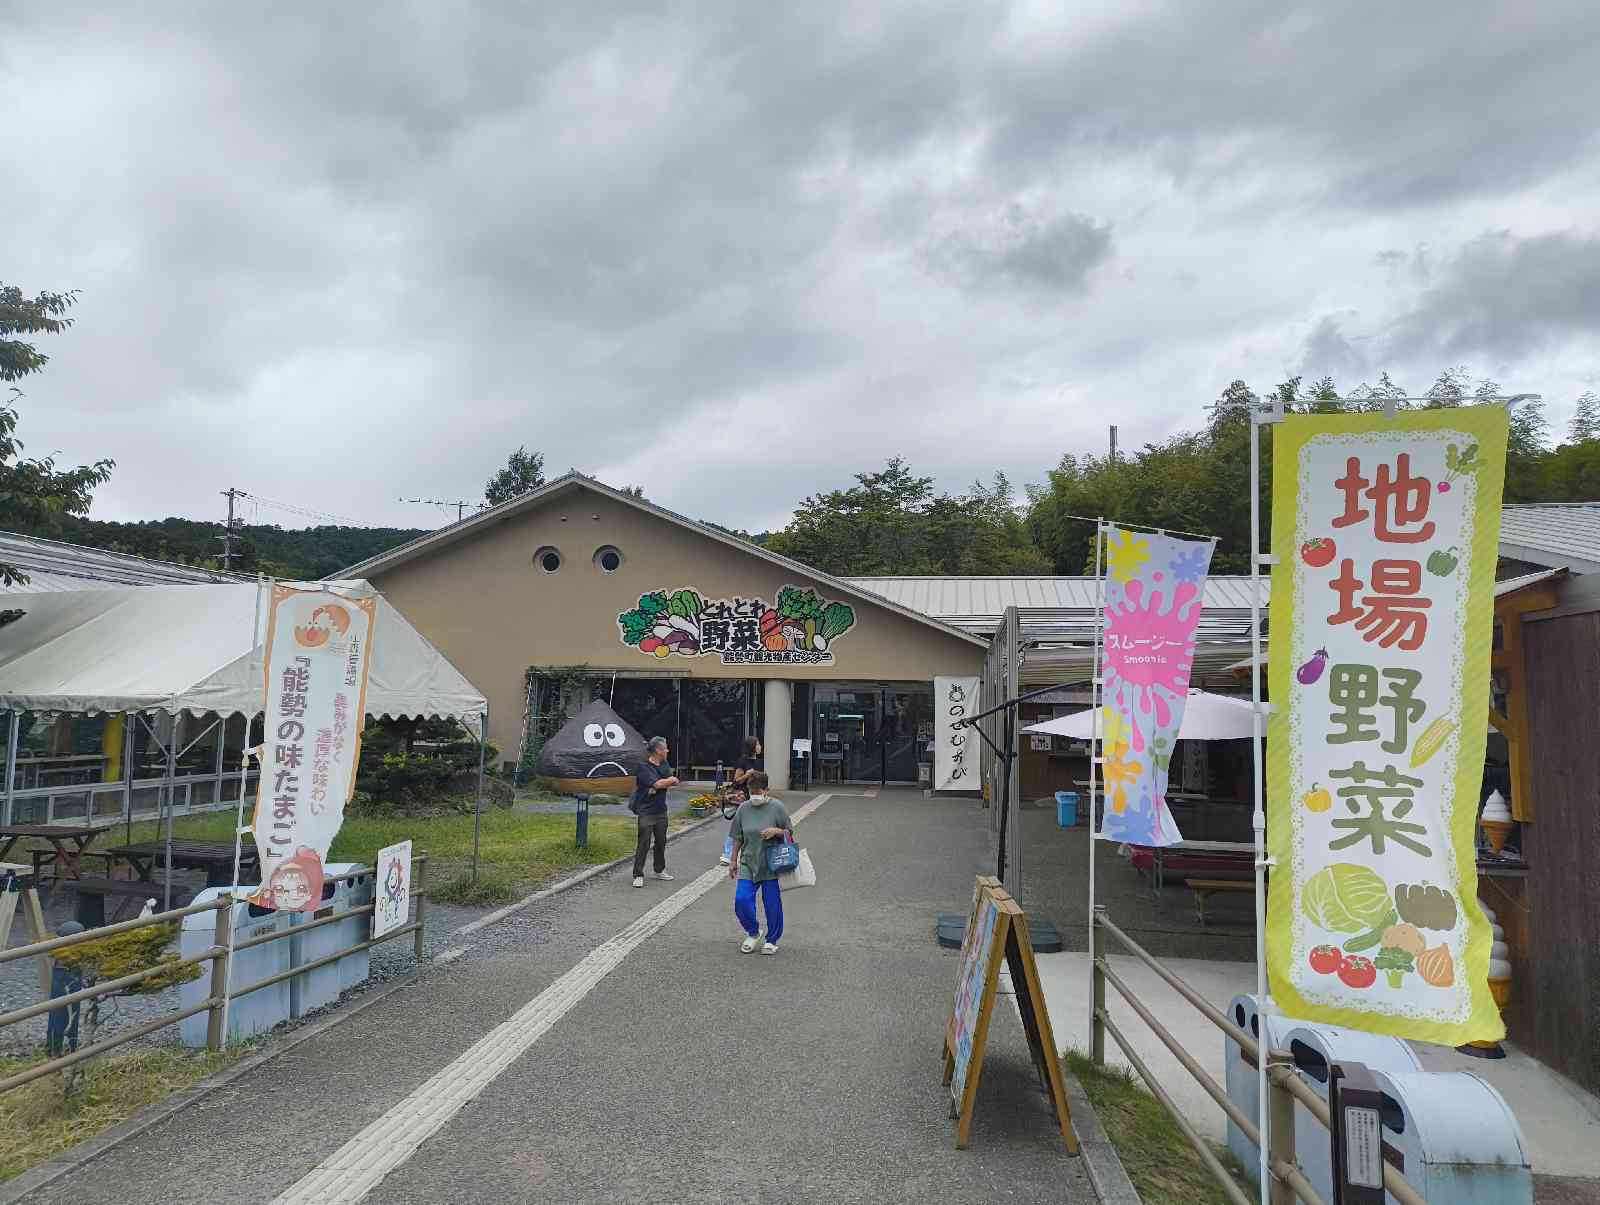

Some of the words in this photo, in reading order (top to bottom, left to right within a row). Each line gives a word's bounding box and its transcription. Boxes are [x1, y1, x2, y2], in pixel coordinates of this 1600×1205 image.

[702, 619, 760, 650] 野菜
[1107, 634, 1184, 650] スムージー
[723, 650, 833, 663] 能勢町観光物産センター
[1325, 452, 1436, 857] 地場野菜
